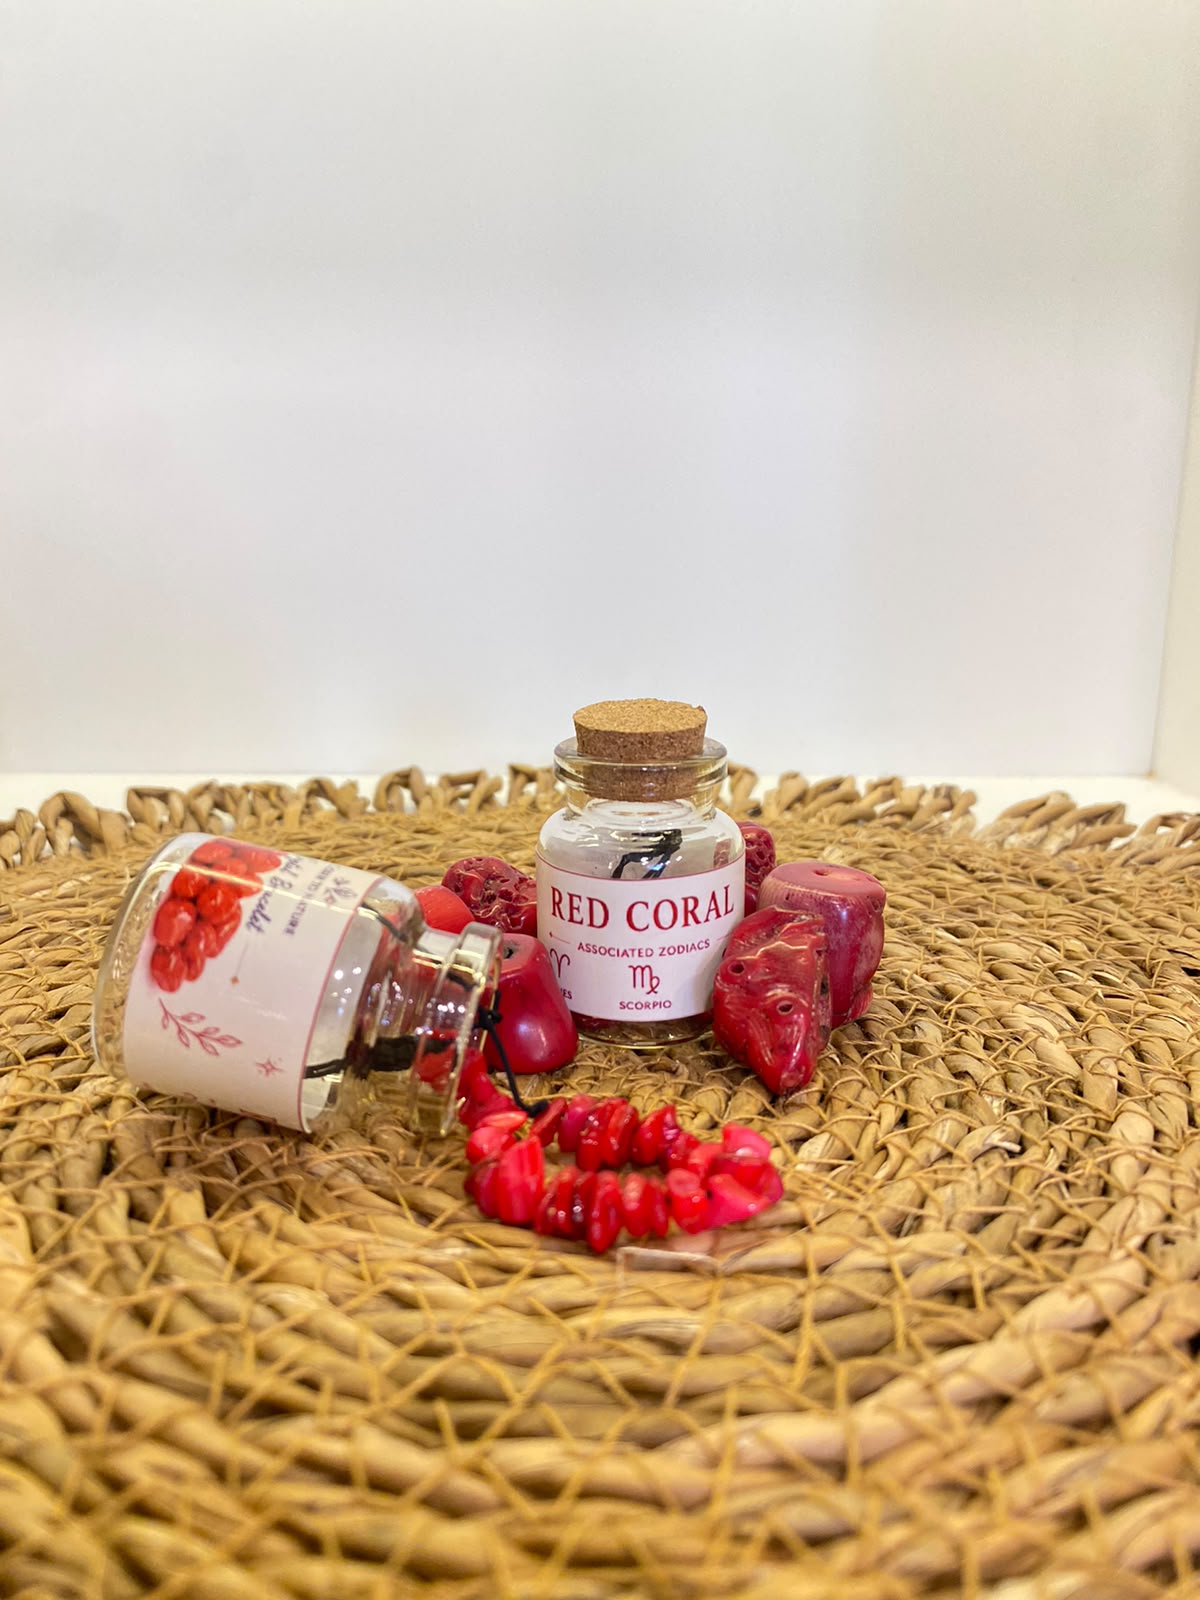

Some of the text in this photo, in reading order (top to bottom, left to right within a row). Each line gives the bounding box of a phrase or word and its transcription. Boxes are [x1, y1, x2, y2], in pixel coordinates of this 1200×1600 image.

[551, 885, 735, 932] RED CORAL
[577, 939, 710, 958] ASSOCIATED ZODIACS
[619, 1000, 672, 1011] SCORPIO
